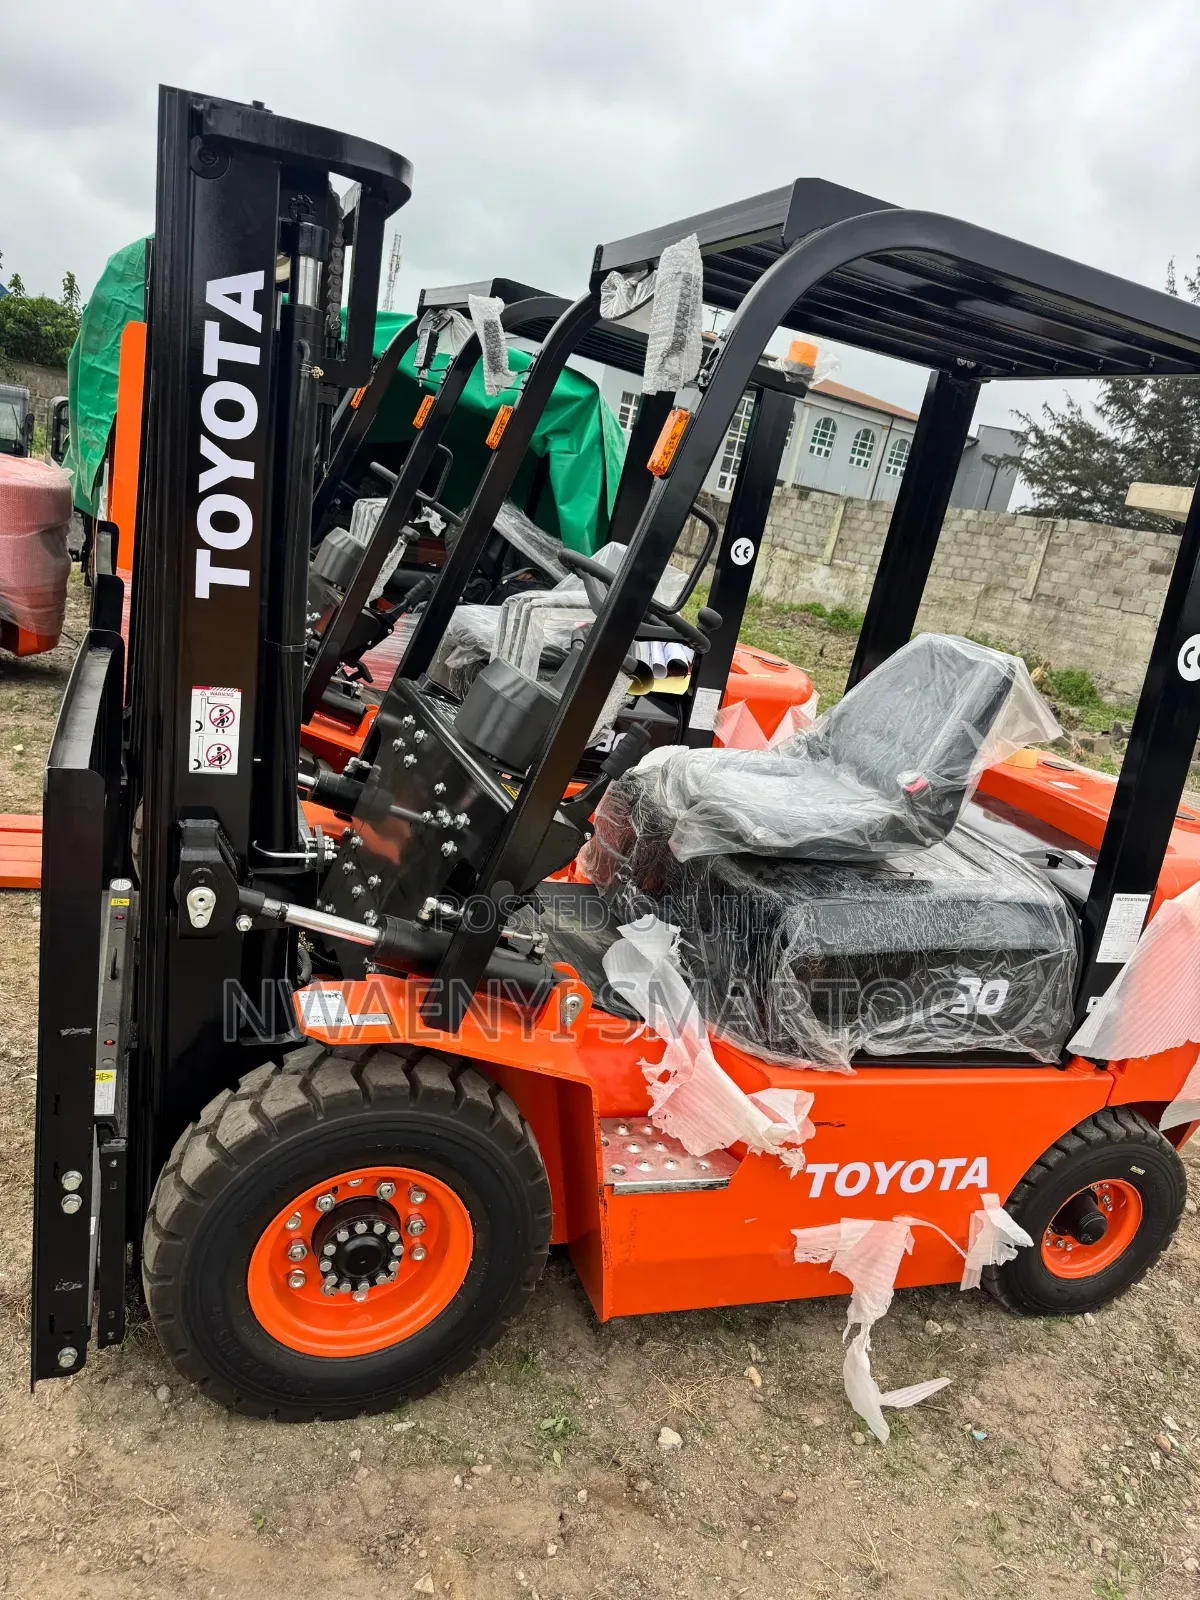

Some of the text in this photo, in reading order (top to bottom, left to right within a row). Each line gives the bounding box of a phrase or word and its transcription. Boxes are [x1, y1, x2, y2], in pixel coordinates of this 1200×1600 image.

[194, 269, 265, 600] TOYOTA
[734, 544, 751, 560] CE
[950, 976, 1010, 1015] 30
[805, 1155, 988, 1199] TOYOTA
